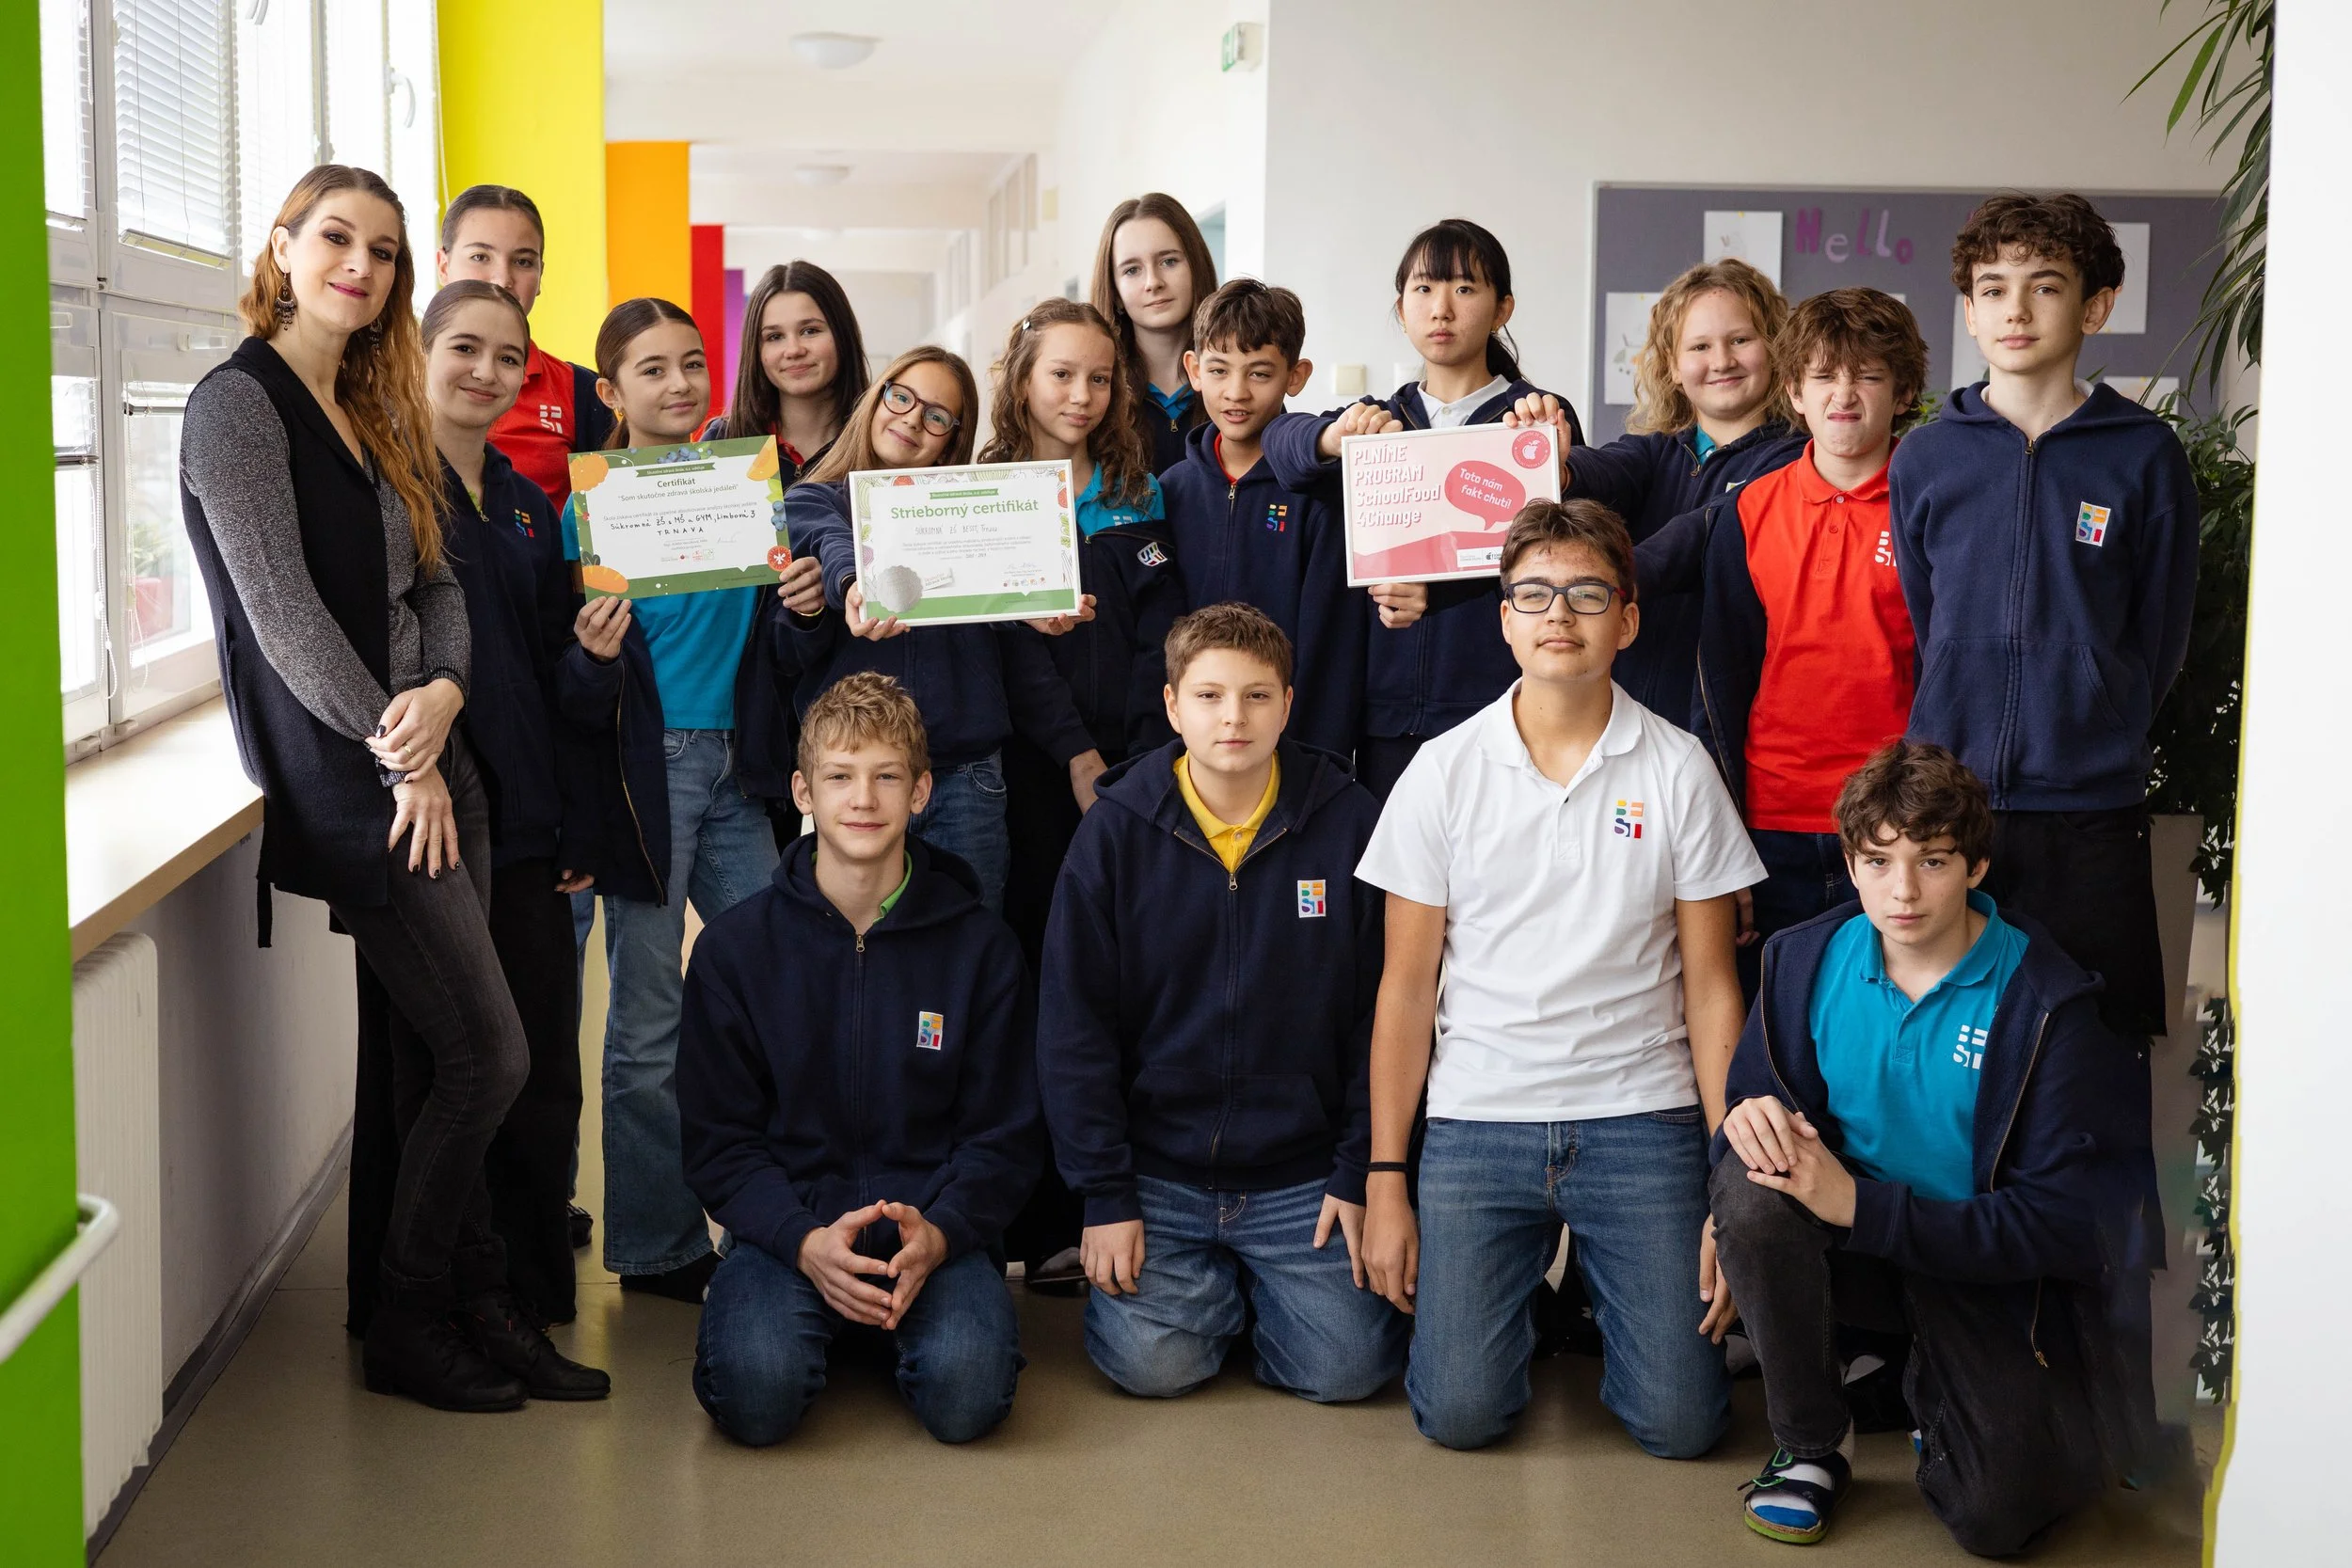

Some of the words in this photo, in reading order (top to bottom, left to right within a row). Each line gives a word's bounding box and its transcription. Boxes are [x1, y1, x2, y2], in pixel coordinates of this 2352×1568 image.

[1795, 206, 1914, 264] Hello
[1354, 444, 1407, 465] PLNÍME
[657, 478, 696, 488] Certifikát
[1355, 465, 1423, 485] PROGRAM
[1483, 477, 1503, 492] nám
[666, 487, 688, 498] zdravá
[689, 484, 712, 496] školská
[1355, 485, 1441, 507] SchoolFood
[1461, 484, 1483, 499] fakt
[891, 502, 968, 519] Strieborný
[973, 499, 1040, 515] certifikát
[1356, 509, 1422, 528] 4Change
